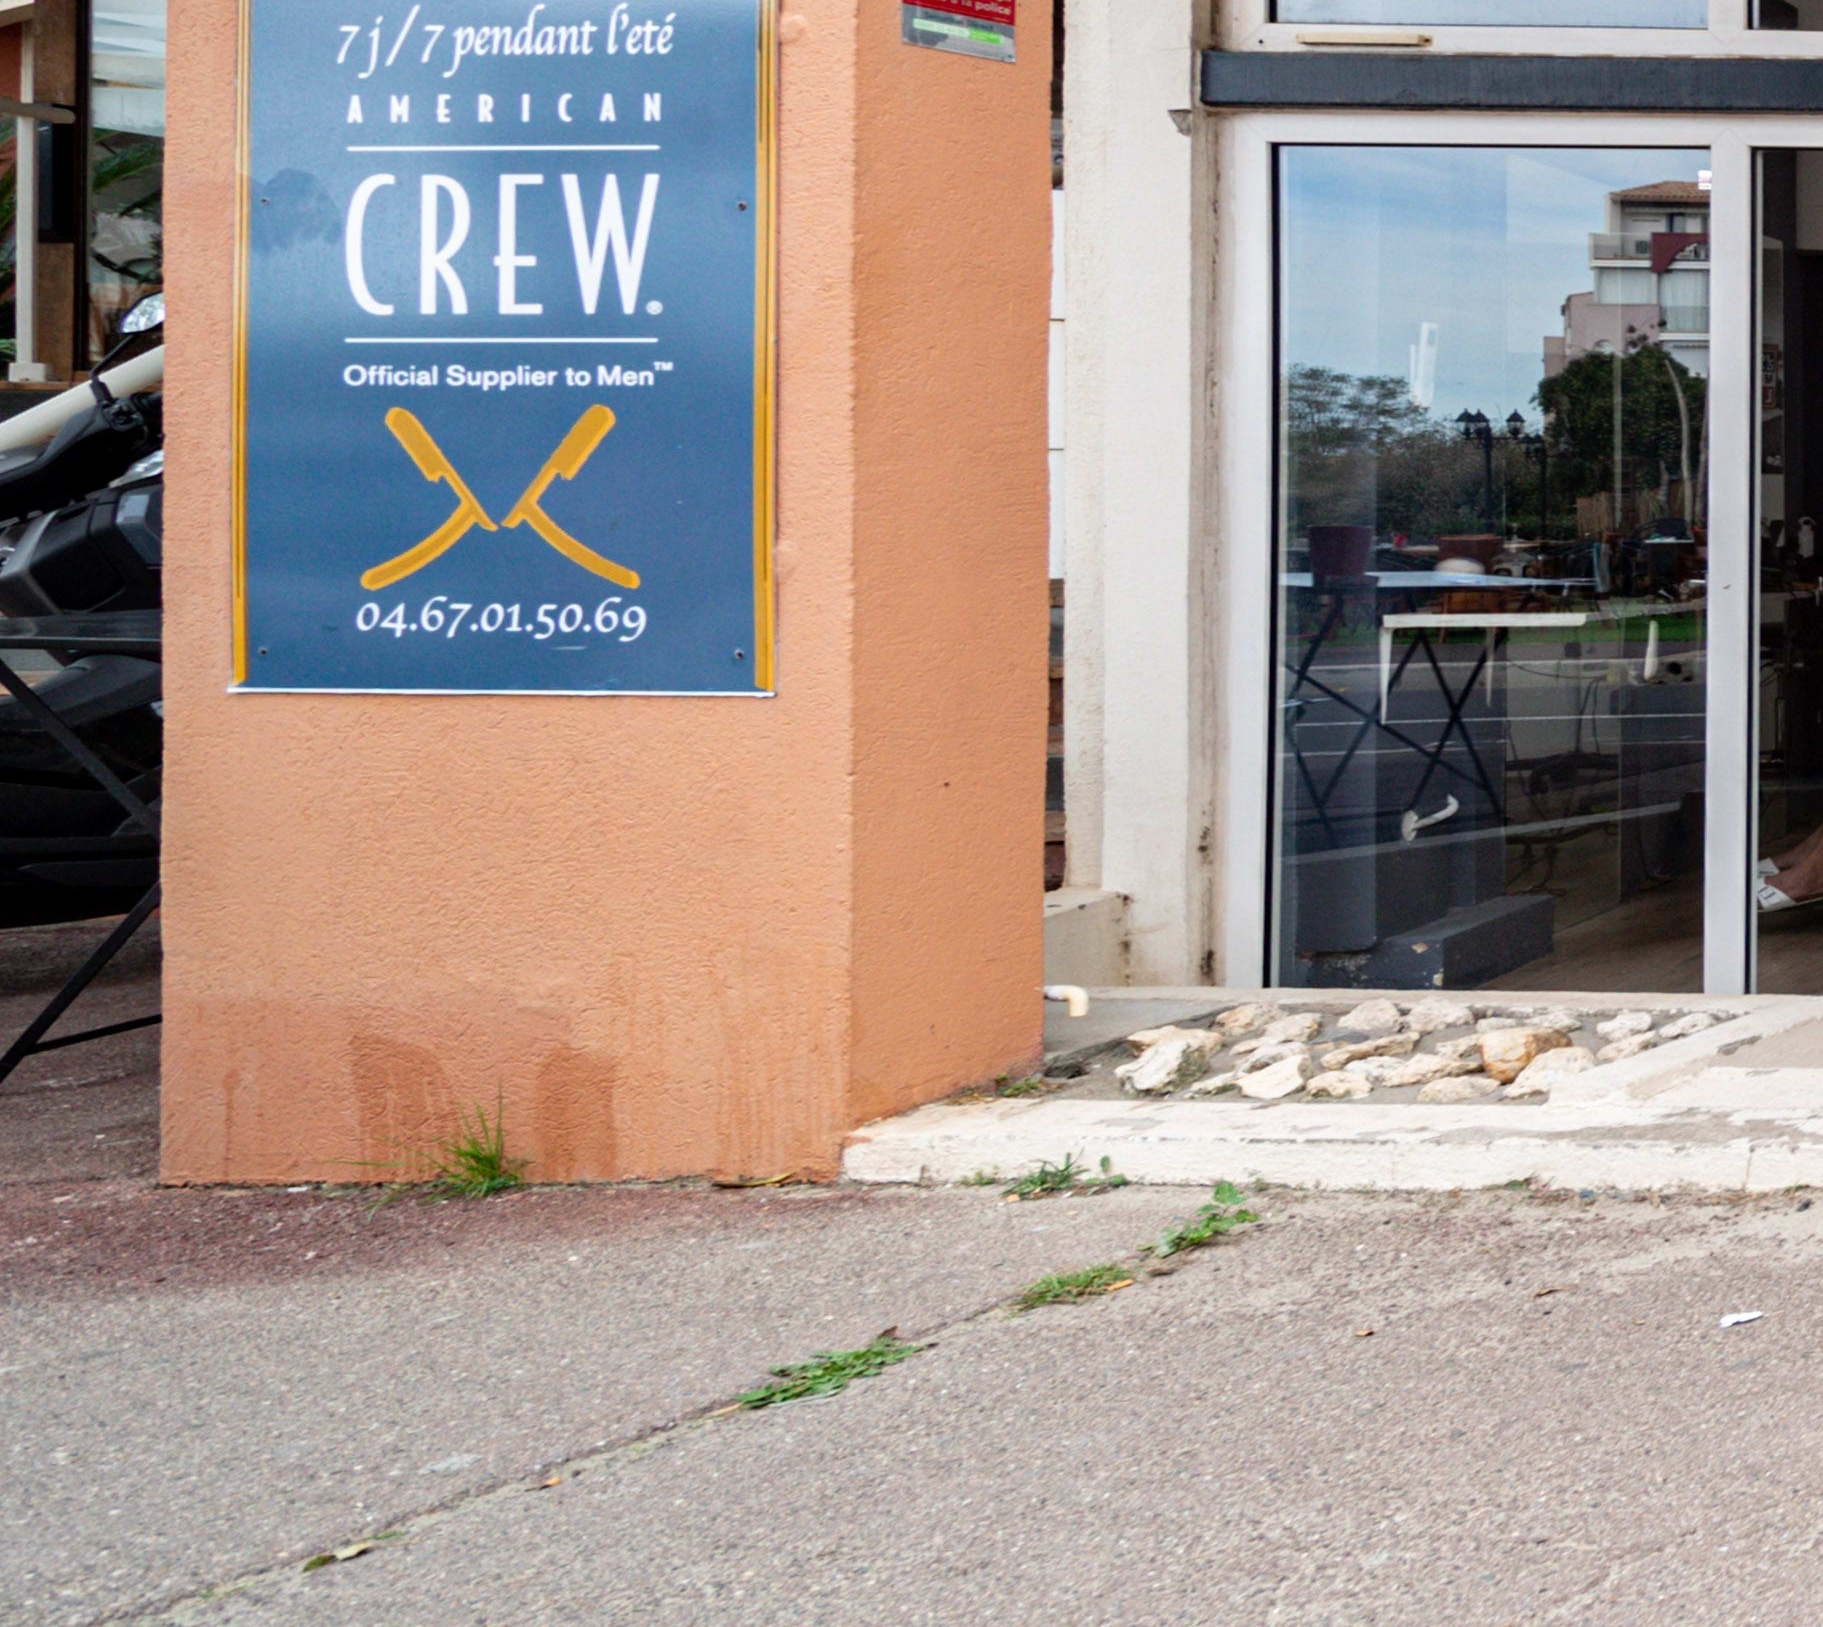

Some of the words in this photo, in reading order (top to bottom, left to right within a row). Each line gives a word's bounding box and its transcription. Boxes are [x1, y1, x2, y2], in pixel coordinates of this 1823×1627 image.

[975, 0, 1012, 16] police
[442, 3, 598, 78] pendant
[346, 93, 662, 124] AMERICAN
[344, 365, 438, 387] Official
[446, 365, 558, 392] Supplier
[566, 368, 591, 387] to
[355, 595, 648, 643] 04.67.01.50.69
